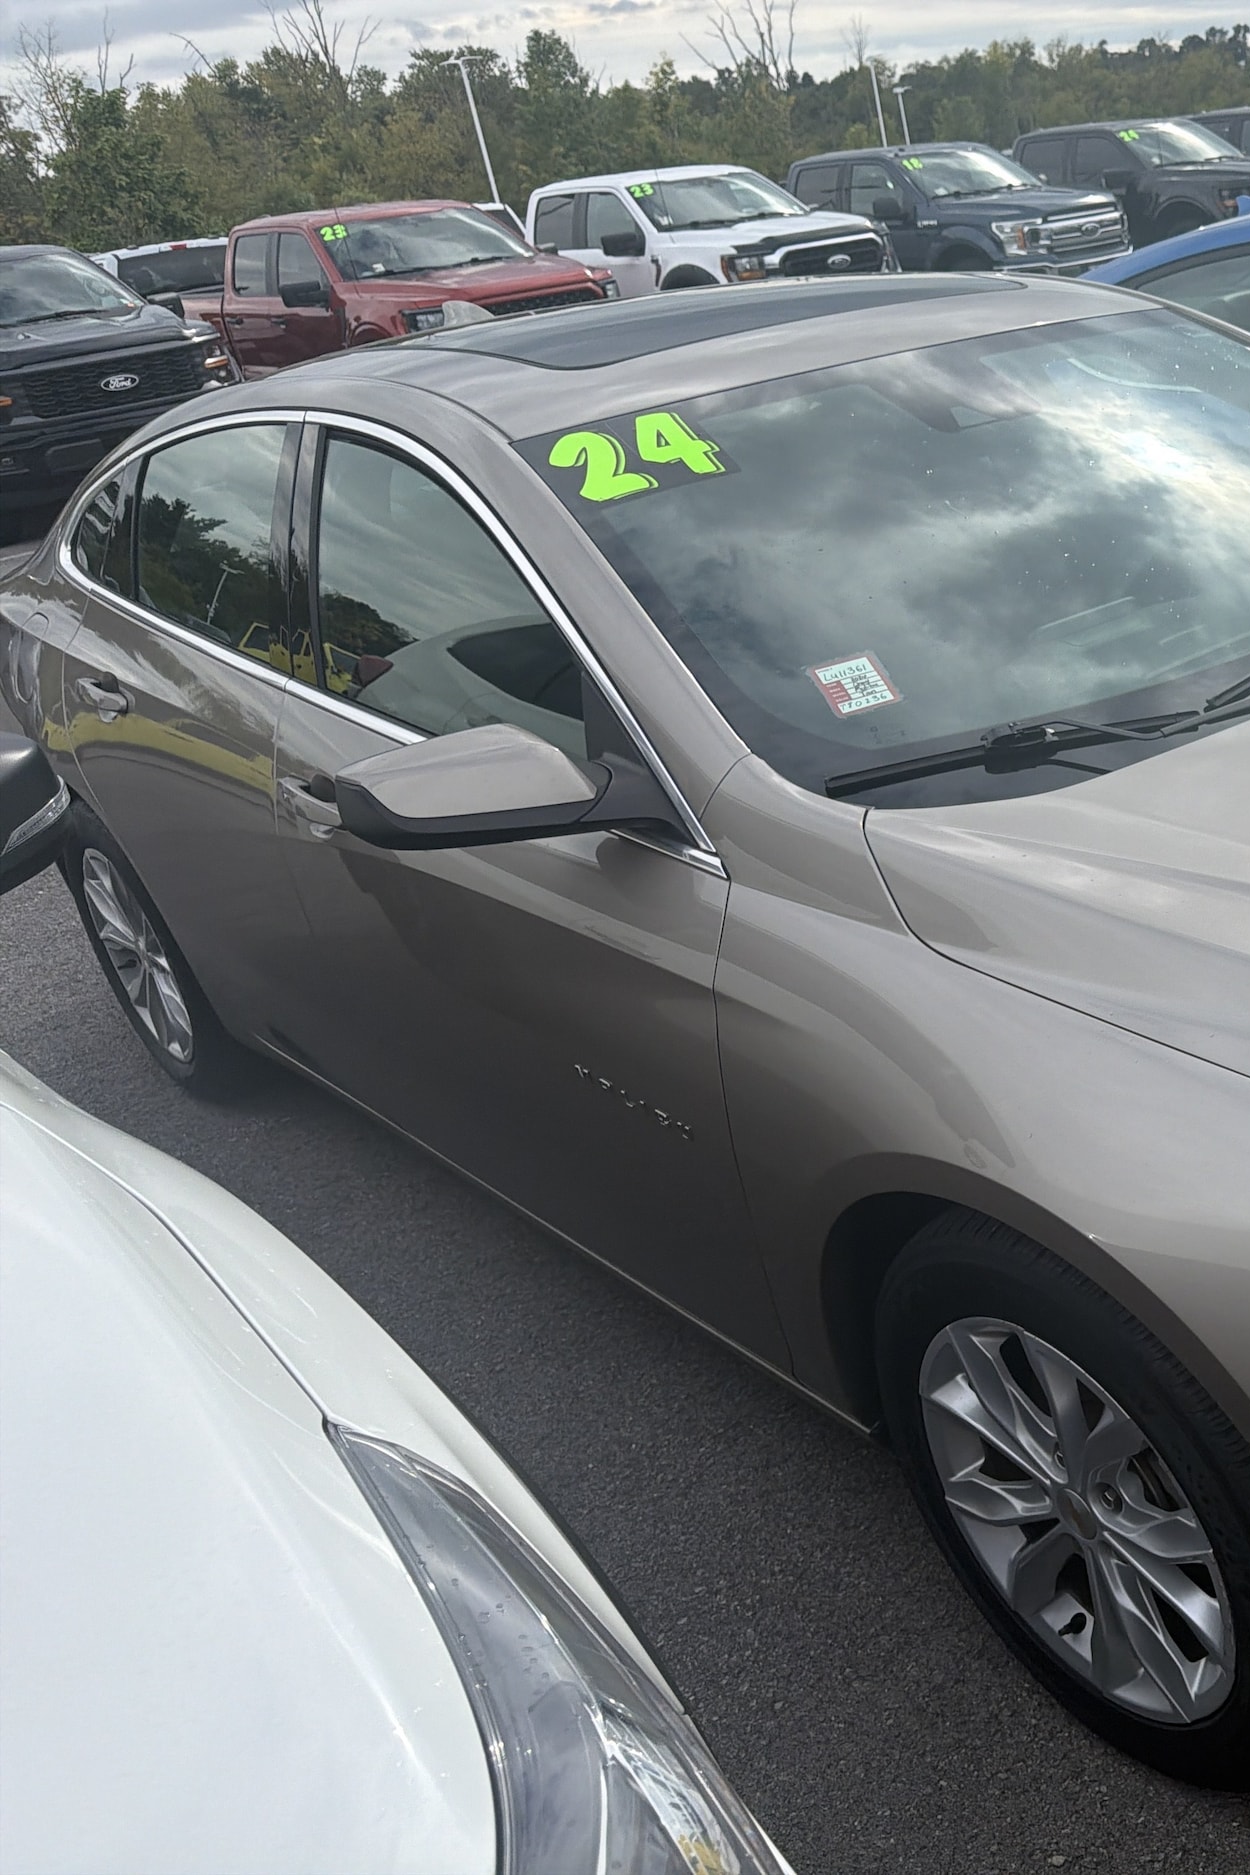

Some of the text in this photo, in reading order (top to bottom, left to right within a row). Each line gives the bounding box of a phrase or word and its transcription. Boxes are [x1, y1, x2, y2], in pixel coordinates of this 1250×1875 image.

[630, 183, 654, 198] 23
[320, 224, 348, 241] 23
[549, 412, 726, 502] 24
